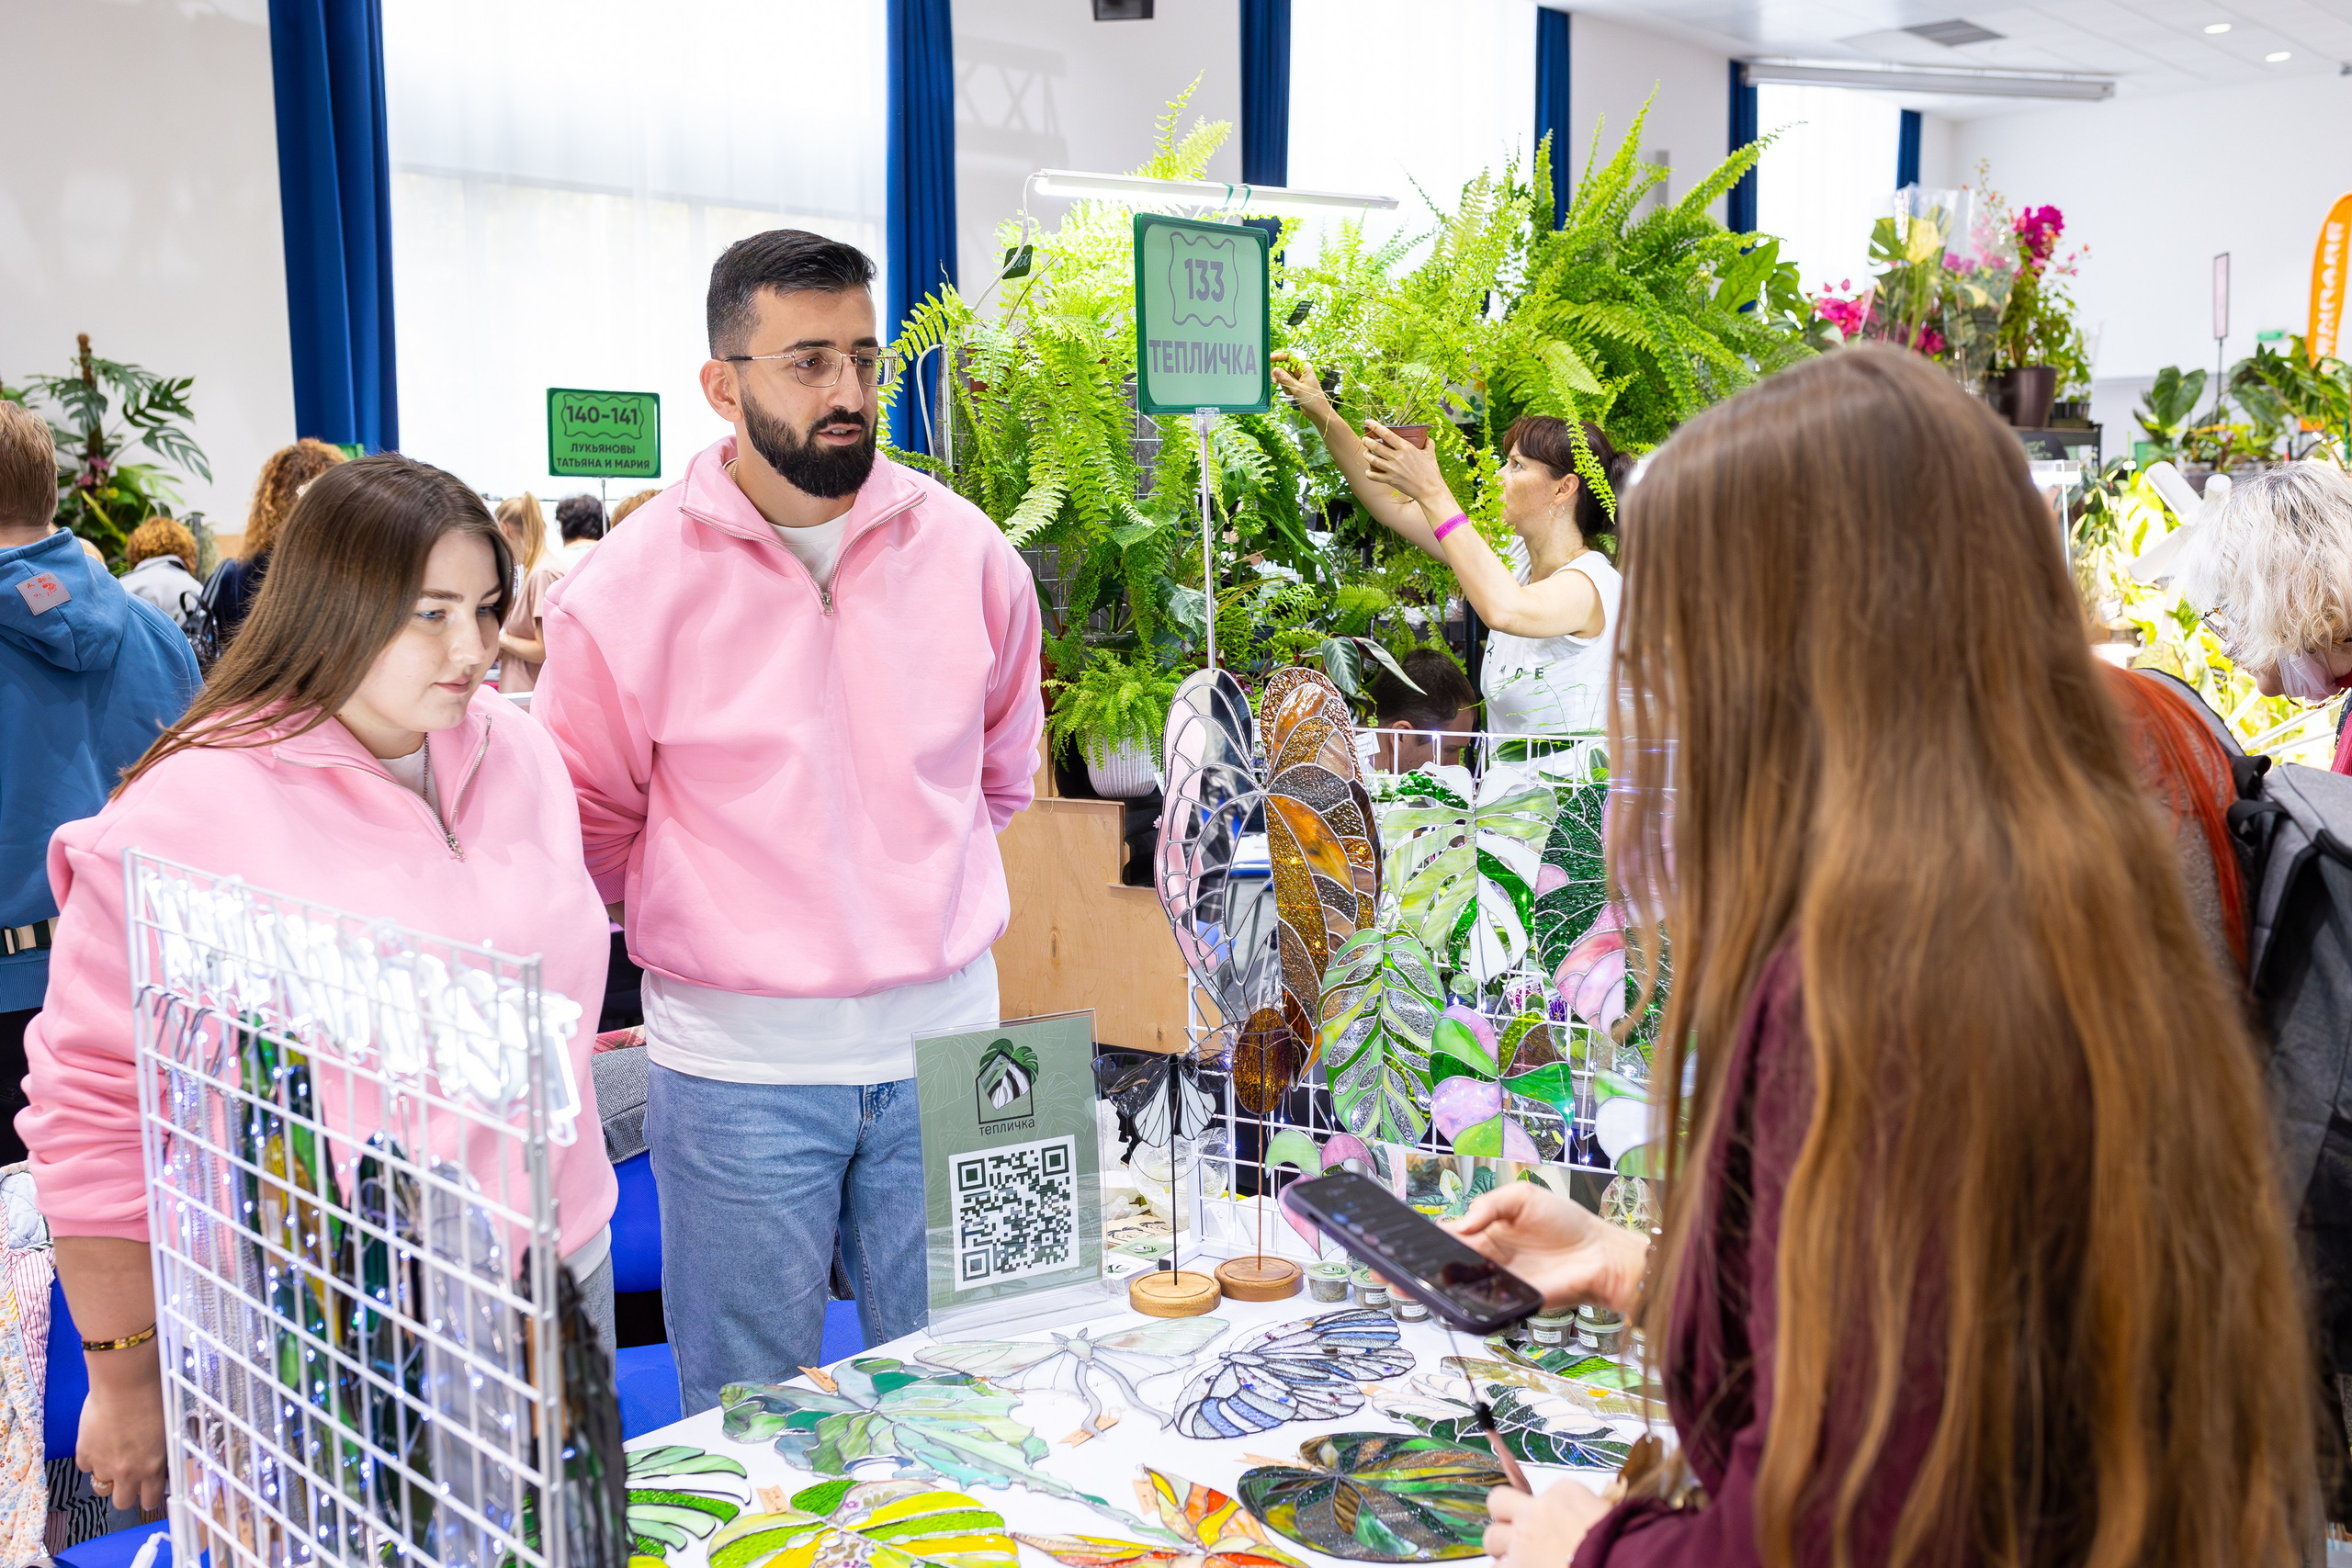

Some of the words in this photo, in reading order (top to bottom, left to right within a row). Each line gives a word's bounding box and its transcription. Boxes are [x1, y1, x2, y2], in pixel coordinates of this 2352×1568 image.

[1184, 258, 1225, 302] 133
[1148, 339, 1258, 376] ТЕПЛИЧКА
[566, 405, 638, 425] 140-141
[571, 443, 636, 454] ЛУКЬЯНОВЫ
[557, 457, 602, 468] ТАТЬЯНА
[605, 459, 612, 468] И
[615, 459, 650, 469] МАРИЯ
[979, 1119, 1035, 1136] тепличка
